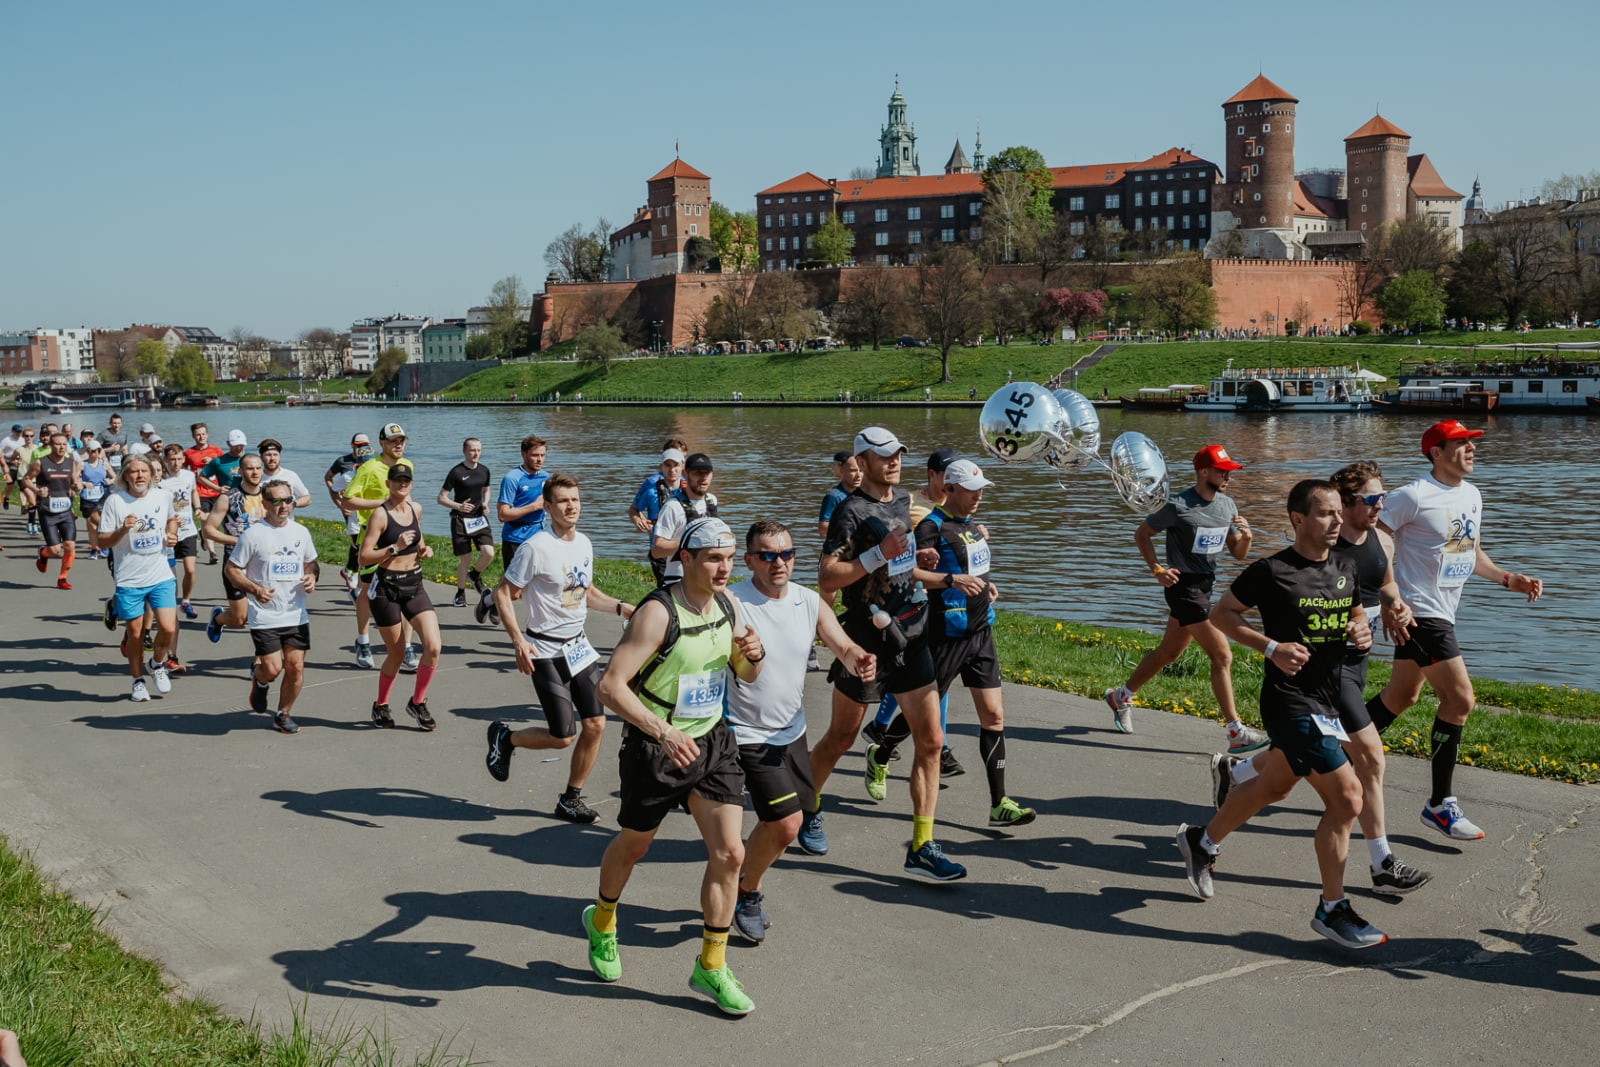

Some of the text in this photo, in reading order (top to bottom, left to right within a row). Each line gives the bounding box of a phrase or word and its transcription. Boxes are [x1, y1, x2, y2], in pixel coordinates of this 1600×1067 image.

[995, 391, 1035, 455] 3:45
[1201, 535, 1222, 546] 2548
[275, 562, 297, 573] 2380
[1307, 611, 1350, 631] 3:45
[689, 685, 720, 704] 1359
